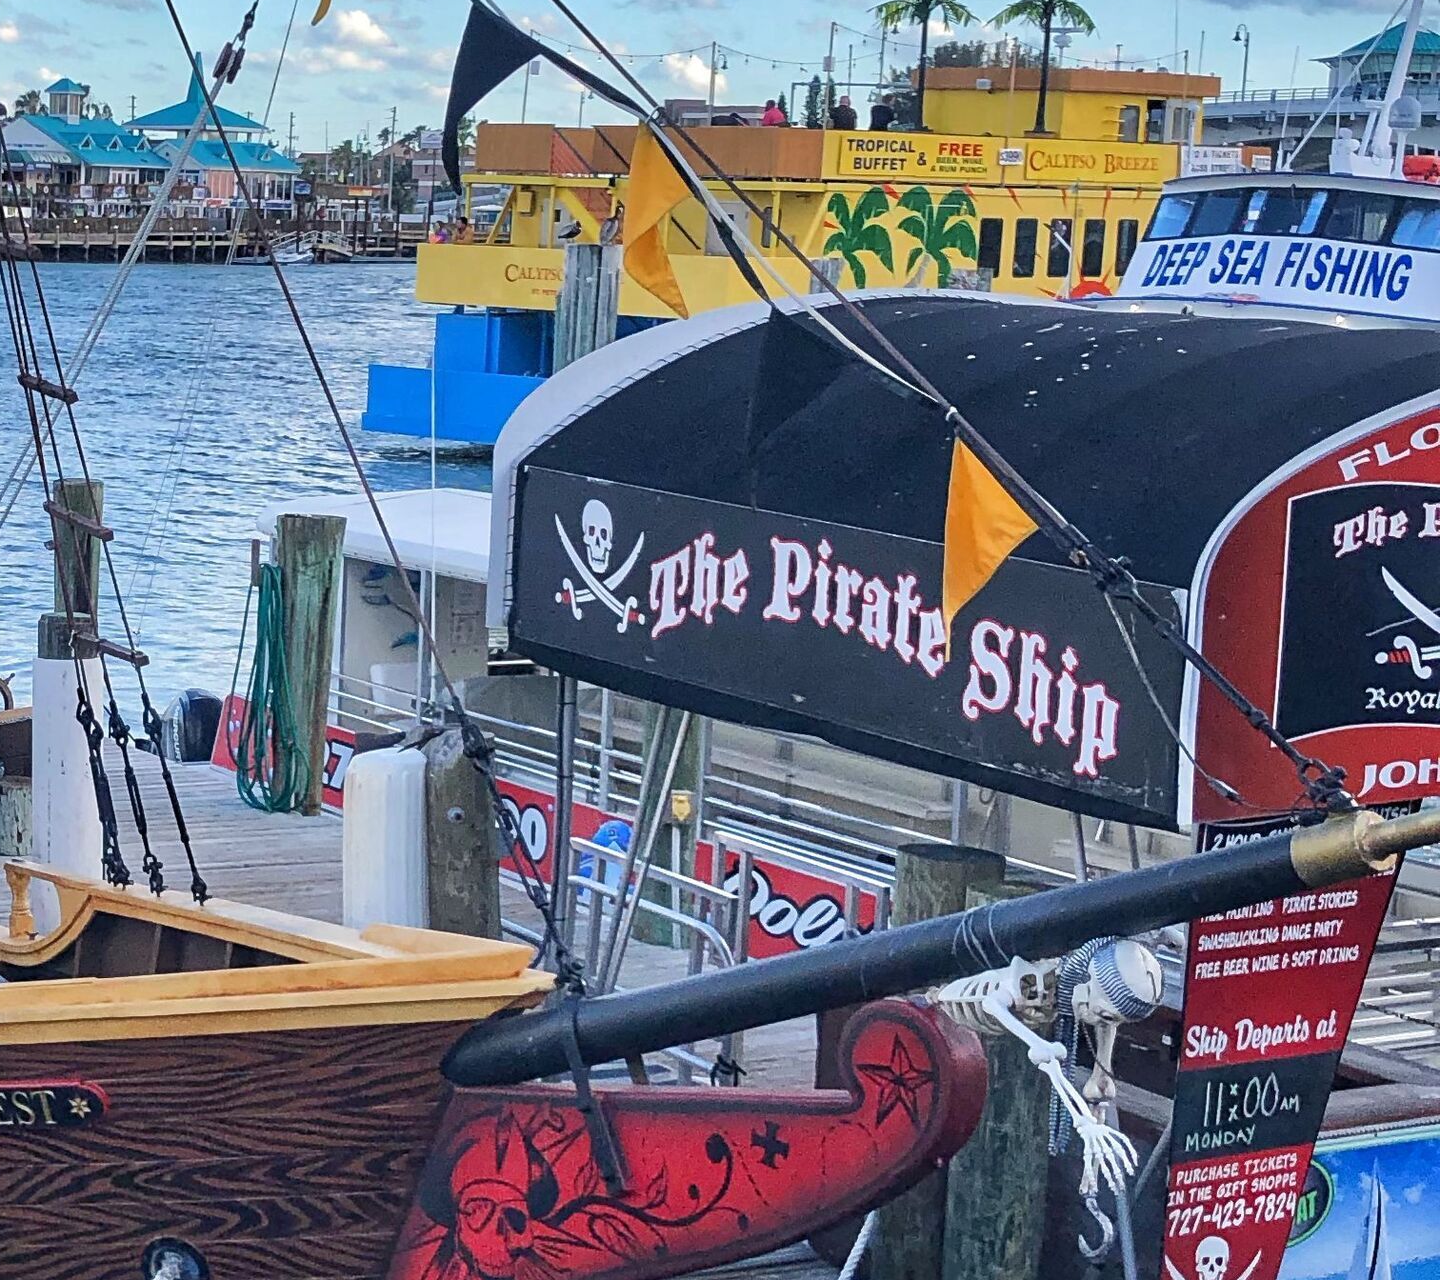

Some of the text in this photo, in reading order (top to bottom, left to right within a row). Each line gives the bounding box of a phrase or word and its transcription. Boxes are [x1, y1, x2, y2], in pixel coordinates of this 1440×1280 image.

[847, 138, 916, 154] TROPICAL
[916, 152, 927, 166] &
[938, 142, 984, 157] FREE
[1030, 149, 1096, 171] CALYPSO
[1103, 153, 1159, 174] BREEZE
[853, 157, 907, 171] BUFFET
[1141, 239, 1413, 302] DEEP SEA FISHING
[1333, 505, 1409, 558] The
[650, 531, 1120, 779] The Pirate Ship
[1282, 894, 1317, 915] PIRATE
[1318, 889, 1358, 911] STORIES
[1198, 919, 1343, 952] SWASHBUCKLING DANCE PARTY
[1195, 944, 1359, 980] FREE BEER WINE & SOFT DRINKS
[1185, 1009, 1338, 1060] Ship Departs at
[1279, 1093, 1301, 1113] AM
[1185, 1124, 1256, 1152] MONDAY
[1176, 1152, 1298, 1187] PURCHASE TICKETS
[1167, 1171, 1297, 1208] IN THE GIFT SHOPPE
[1168, 1190, 1297, 1238] 727-423-7824
